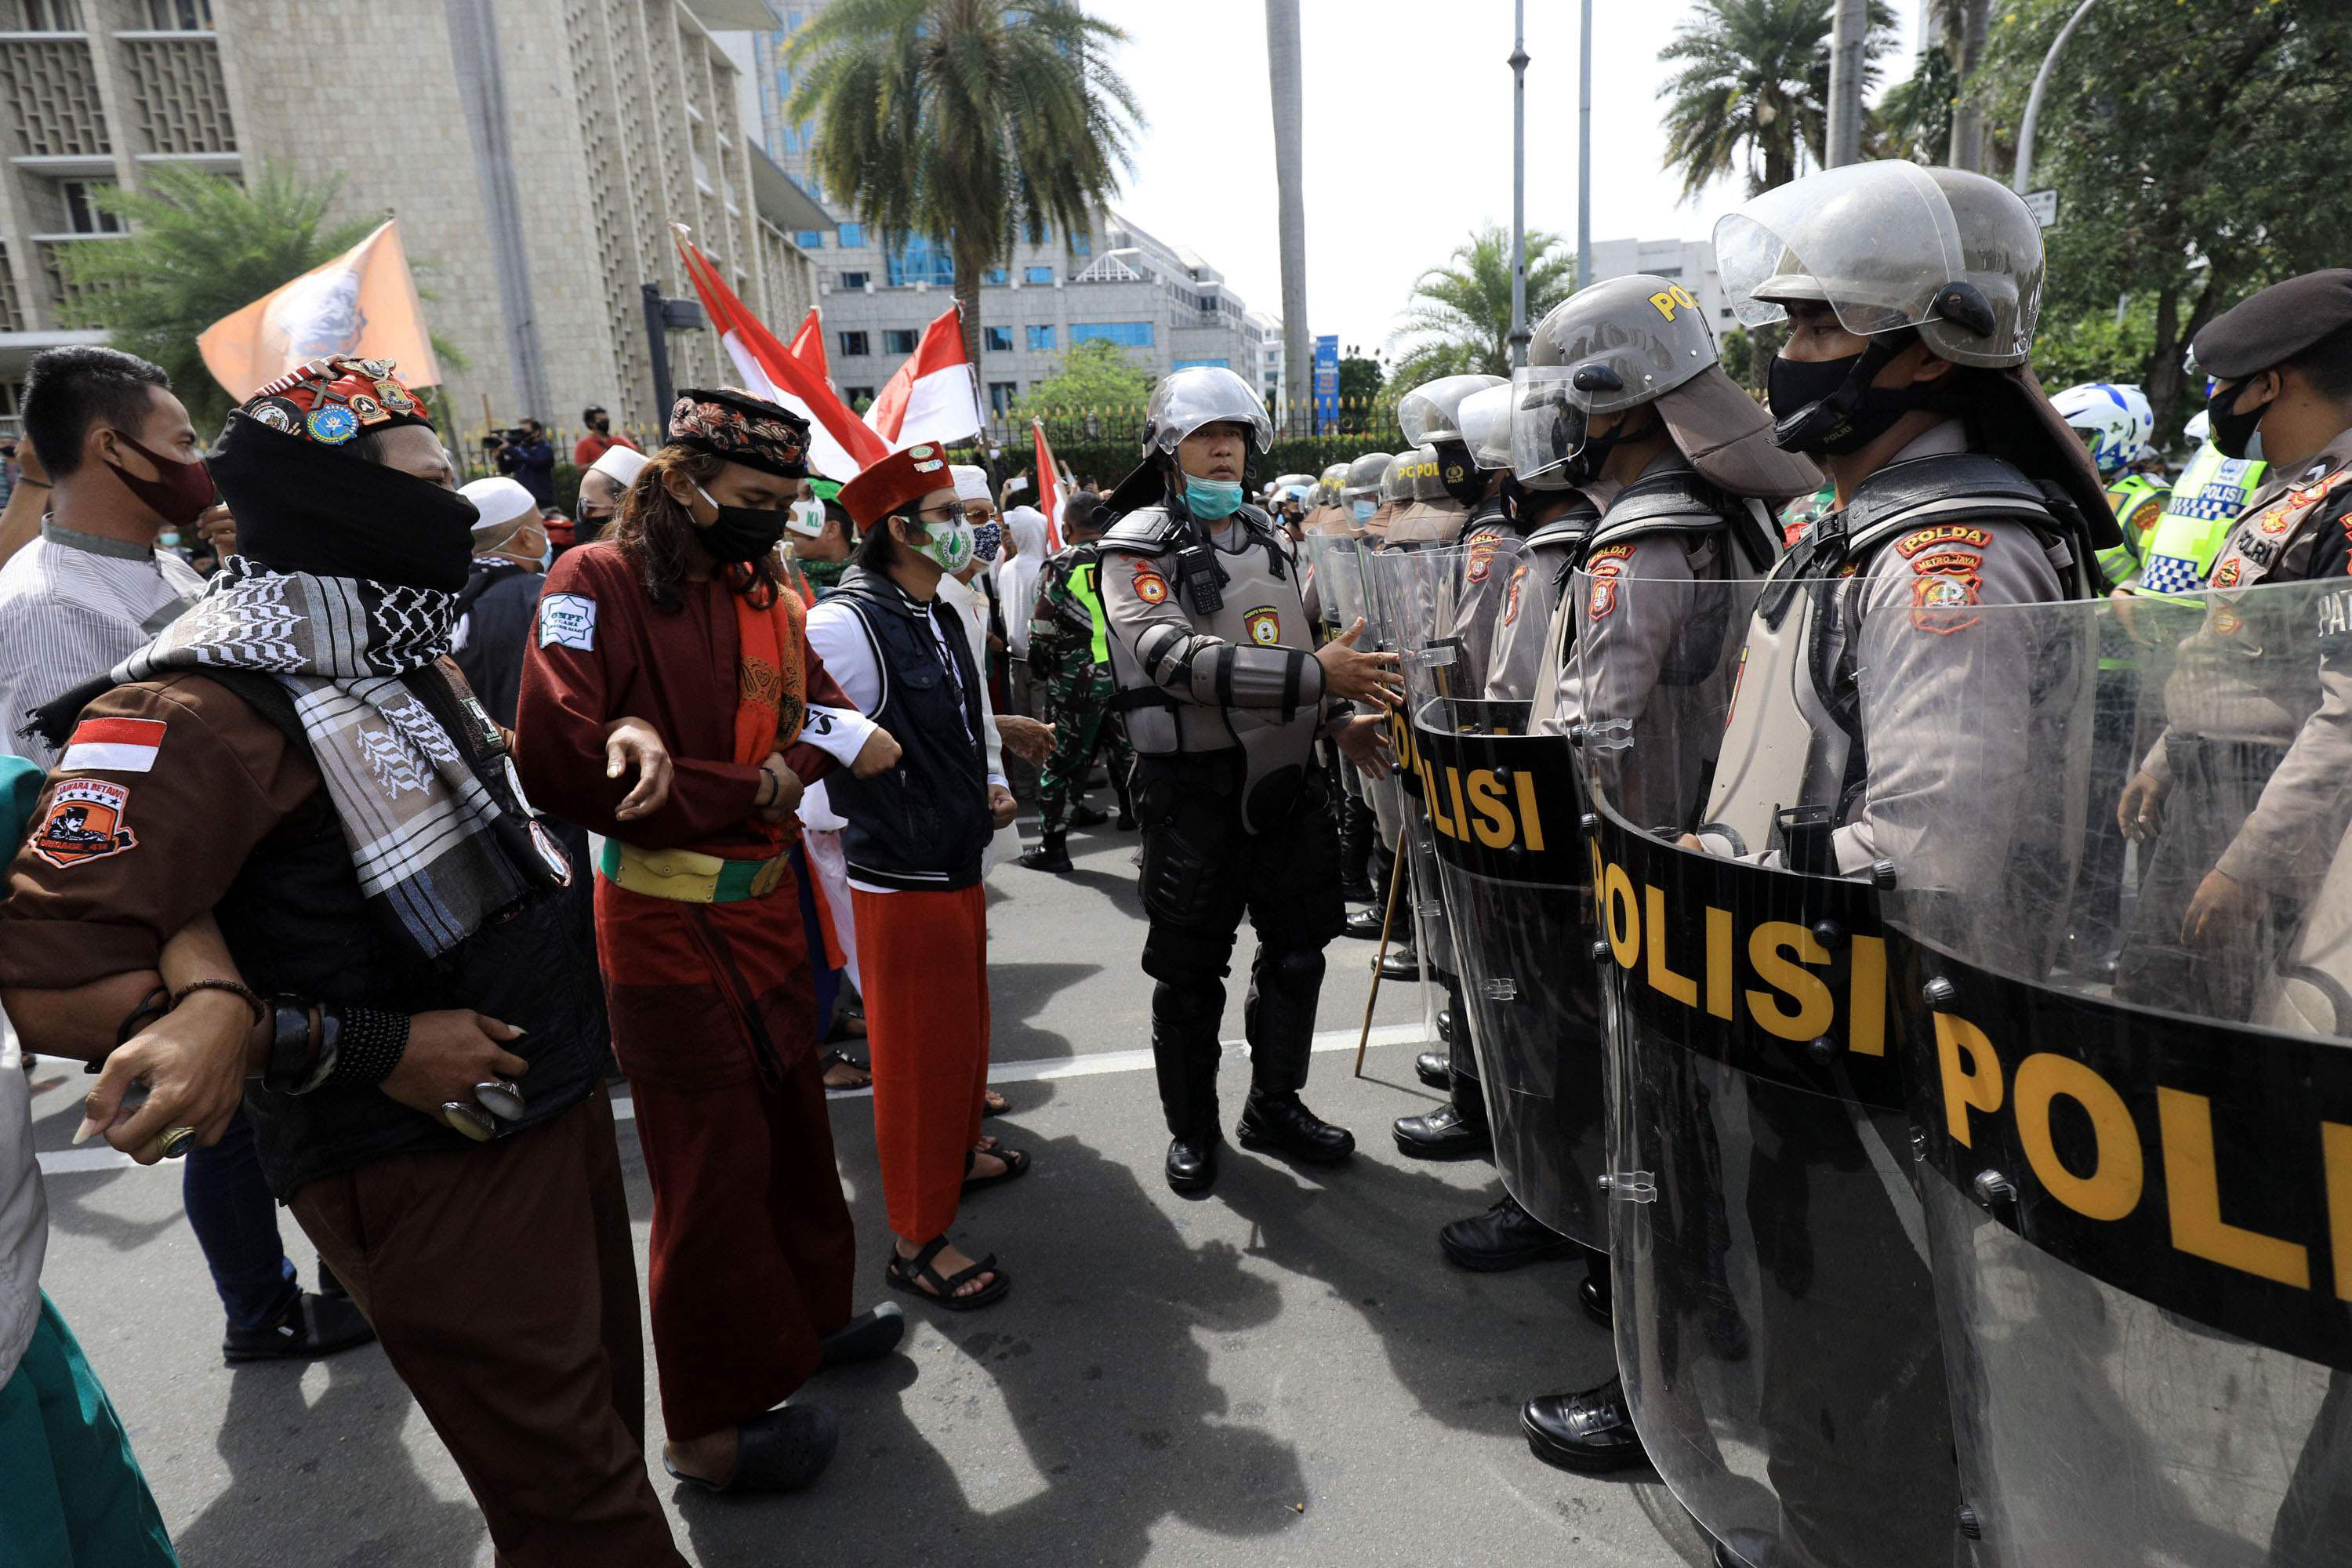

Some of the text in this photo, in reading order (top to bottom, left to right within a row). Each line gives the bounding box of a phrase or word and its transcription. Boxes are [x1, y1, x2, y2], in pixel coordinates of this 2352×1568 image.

[1647, 285, 1697, 323] PO
[1823, 426, 1853, 445] POLRI
[2200, 485, 2245, 503] POLISI
[1904, 527, 1982, 550] POLDA
[57, 782, 125, 800] JAWARA BETAWI
[1592, 836, 1886, 1057] POLISI
